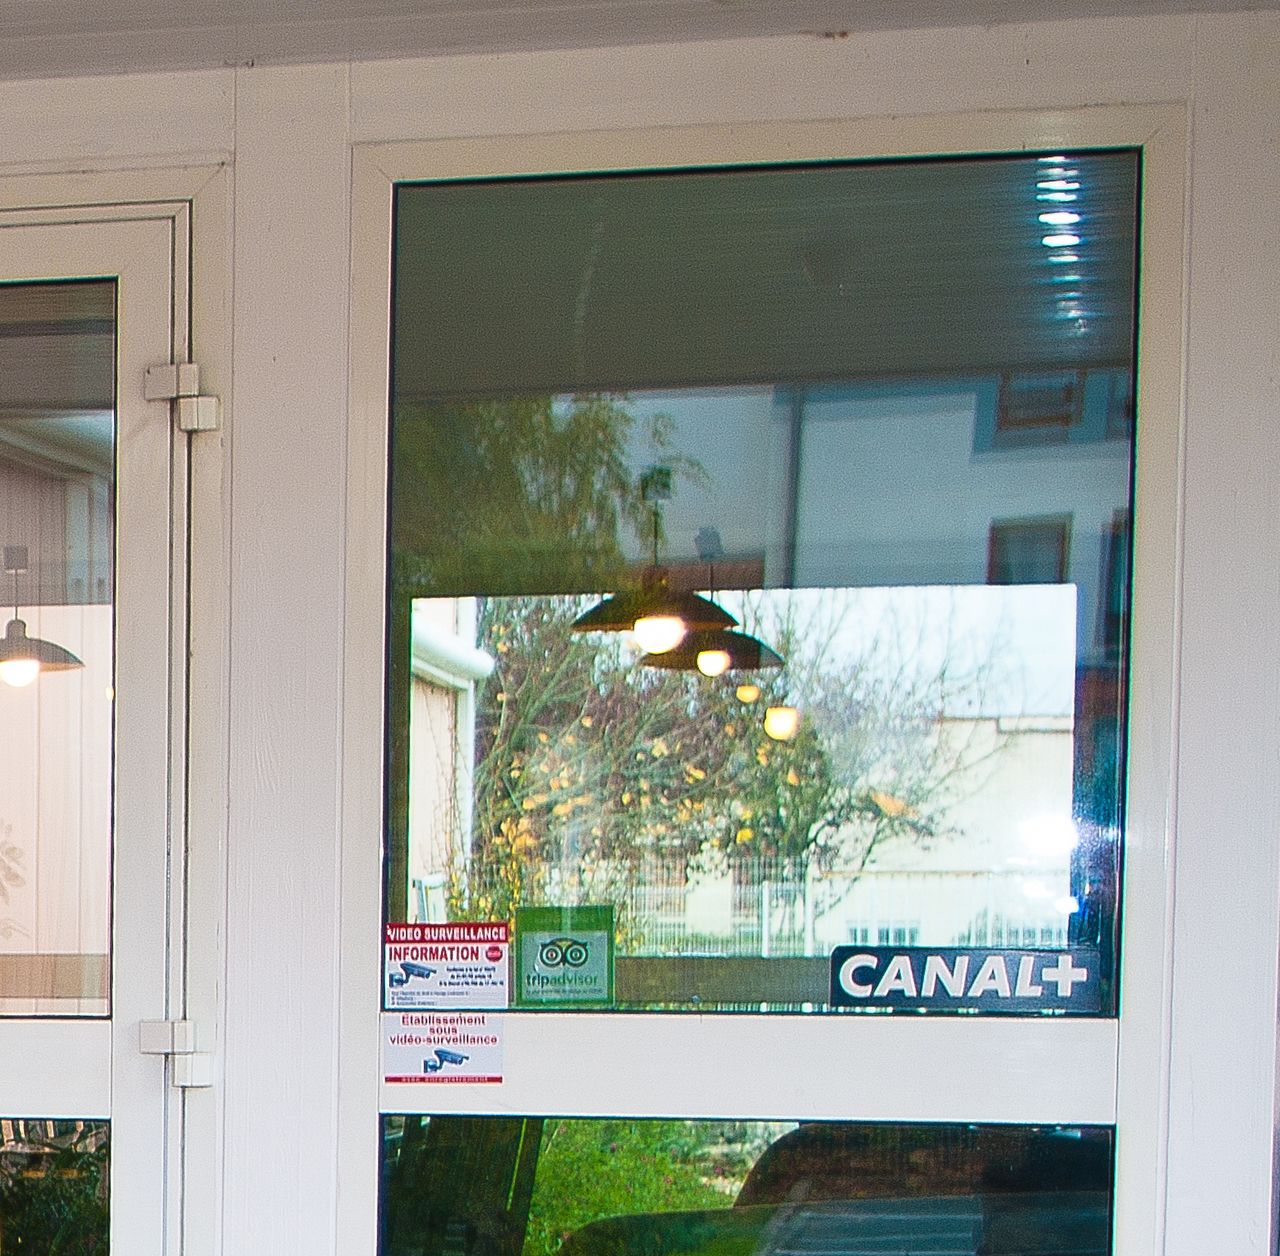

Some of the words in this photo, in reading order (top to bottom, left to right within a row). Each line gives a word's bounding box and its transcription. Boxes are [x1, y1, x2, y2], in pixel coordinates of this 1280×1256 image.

[388, 927, 421, 941] VIDEO
[424, 926, 506, 941] SURVEILLANCE
[389, 946, 479, 961] INFORMATION
[526, 973, 598, 988] tripadvisor
[840, 954, 1088, 998] CANAL+
[429, 1026, 457, 1035] sous
[389, 1034, 497, 1045] vidéo-surveillance
